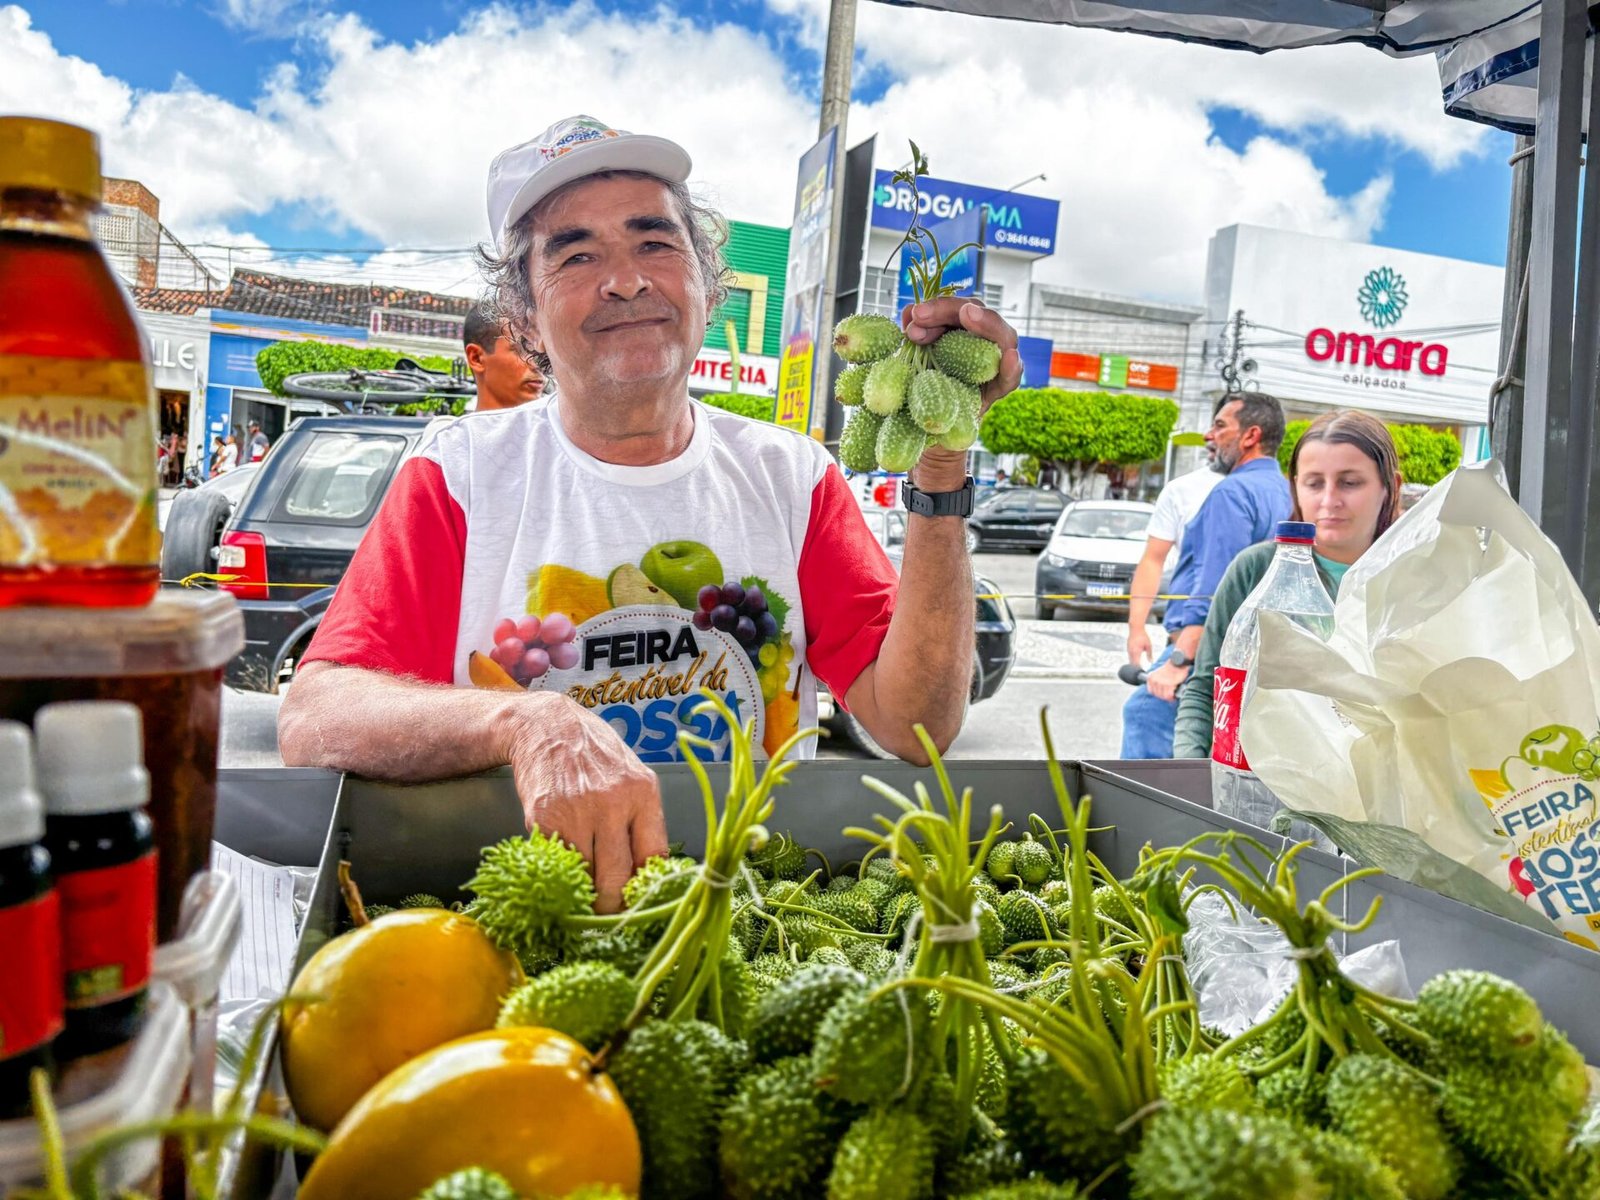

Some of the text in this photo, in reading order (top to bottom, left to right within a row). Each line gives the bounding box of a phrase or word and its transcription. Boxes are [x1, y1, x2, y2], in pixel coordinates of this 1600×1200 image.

[1305, 327, 1448, 376] omara
[1343, 373, 1406, 389] calçados
[583, 625, 700, 671] FEIRA
[700, 650, 729, 691] da
[599, 690, 742, 752] OSSA
[1502, 783, 1593, 837] FEIRA
